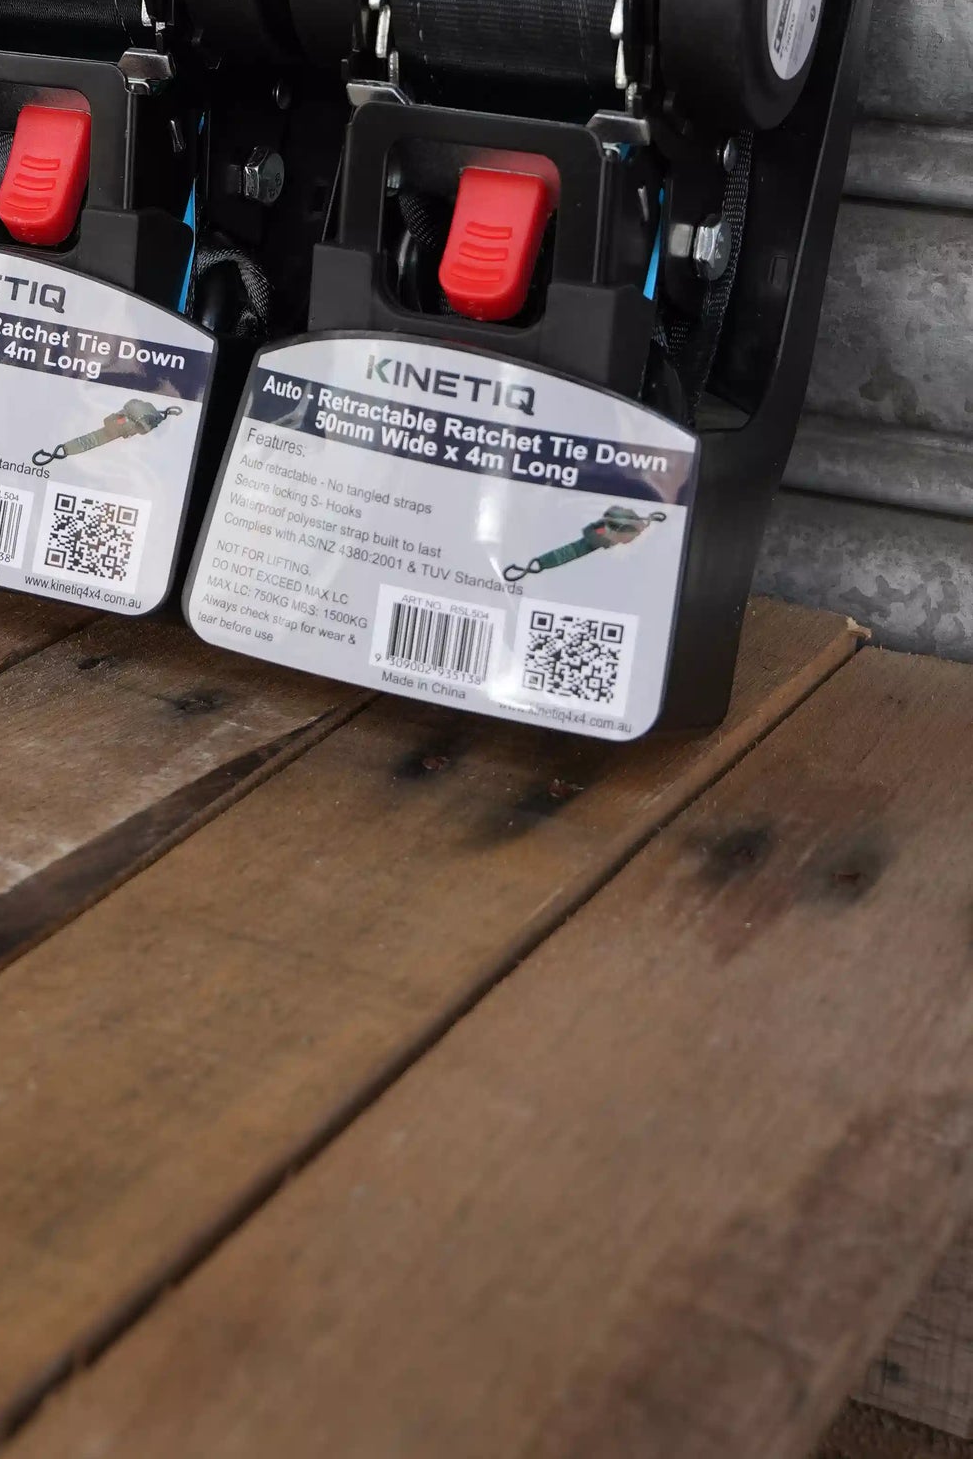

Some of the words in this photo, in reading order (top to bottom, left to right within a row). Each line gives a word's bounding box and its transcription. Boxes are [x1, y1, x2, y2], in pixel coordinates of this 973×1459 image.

[3, 340, 37, 362] 4m
[42, 348, 102, 379] Long
[75, 333, 111, 355] Tie
[118, 341, 185, 370] Down
[366, 355, 534, 416] KINETIQ
[246, 427, 308, 456] Features:
[262, 374, 303, 399] Auto
[316, 388, 438, 432] Retractable
[443, 418, 541, 453] Ratchet
[547, 437, 589, 460] Tie
[595, 444, 667, 471] Down
[314, 411, 375, 440] 50mm
[379, 427, 438, 455] Wide
[443, 445, 459, 460] x
[464, 445, 504, 469] 4m
[510, 454, 579, 486] Long
[234, 473, 271, 493] Secure
[271, 484, 309, 506] locking
[310, 495, 323, 507] S-
[325, 499, 362, 517] Hooks
[239, 454, 264, 469] Auto
[265, 462, 318, 485] retractable
[327, 478, 344, 491] No
[345, 483, 390, 506] tangled
[392, 495, 433, 515] straps
[223, 512, 273, 537] Complies
[274, 526, 296, 541] with
[297, 533, 335, 552] AS/NZ
[337, 544, 402, 569] 4380:2001
[407, 561, 417, 572] &
[419, 564, 449, 580] TUV
[228, 492, 286, 519] Waterproof
[286, 510, 337, 534] polyester
[339, 523, 369, 542] strap
[372, 532, 399, 548] built
[402, 540, 414, 551] to
[418, 543, 441, 557] last
[216, 540, 239, 554] NOT
[241, 547, 264, 562] FOR
[265, 555, 312, 575] LIFTING.
[25, 575, 142, 609] www.kinetiq4x4.com.au
[211, 558, 228, 570] DO
[230, 564, 254, 578] NOT
[255, 571, 302, 591] EXCEED
[304, 584, 331, 600] MAX
[332, 592, 348, 604] LC
[196, 612, 217, 624] tear
[219, 618, 253, 634] before
[254, 630, 274, 641] use
[233, 584, 251, 596] LC:
[253, 589, 289, 607] 750KG
[322, 609, 369, 628] 1500KG
[382, 671, 414, 686] Made
[418, 679, 428, 690] in
[431, 682, 466, 699] China
